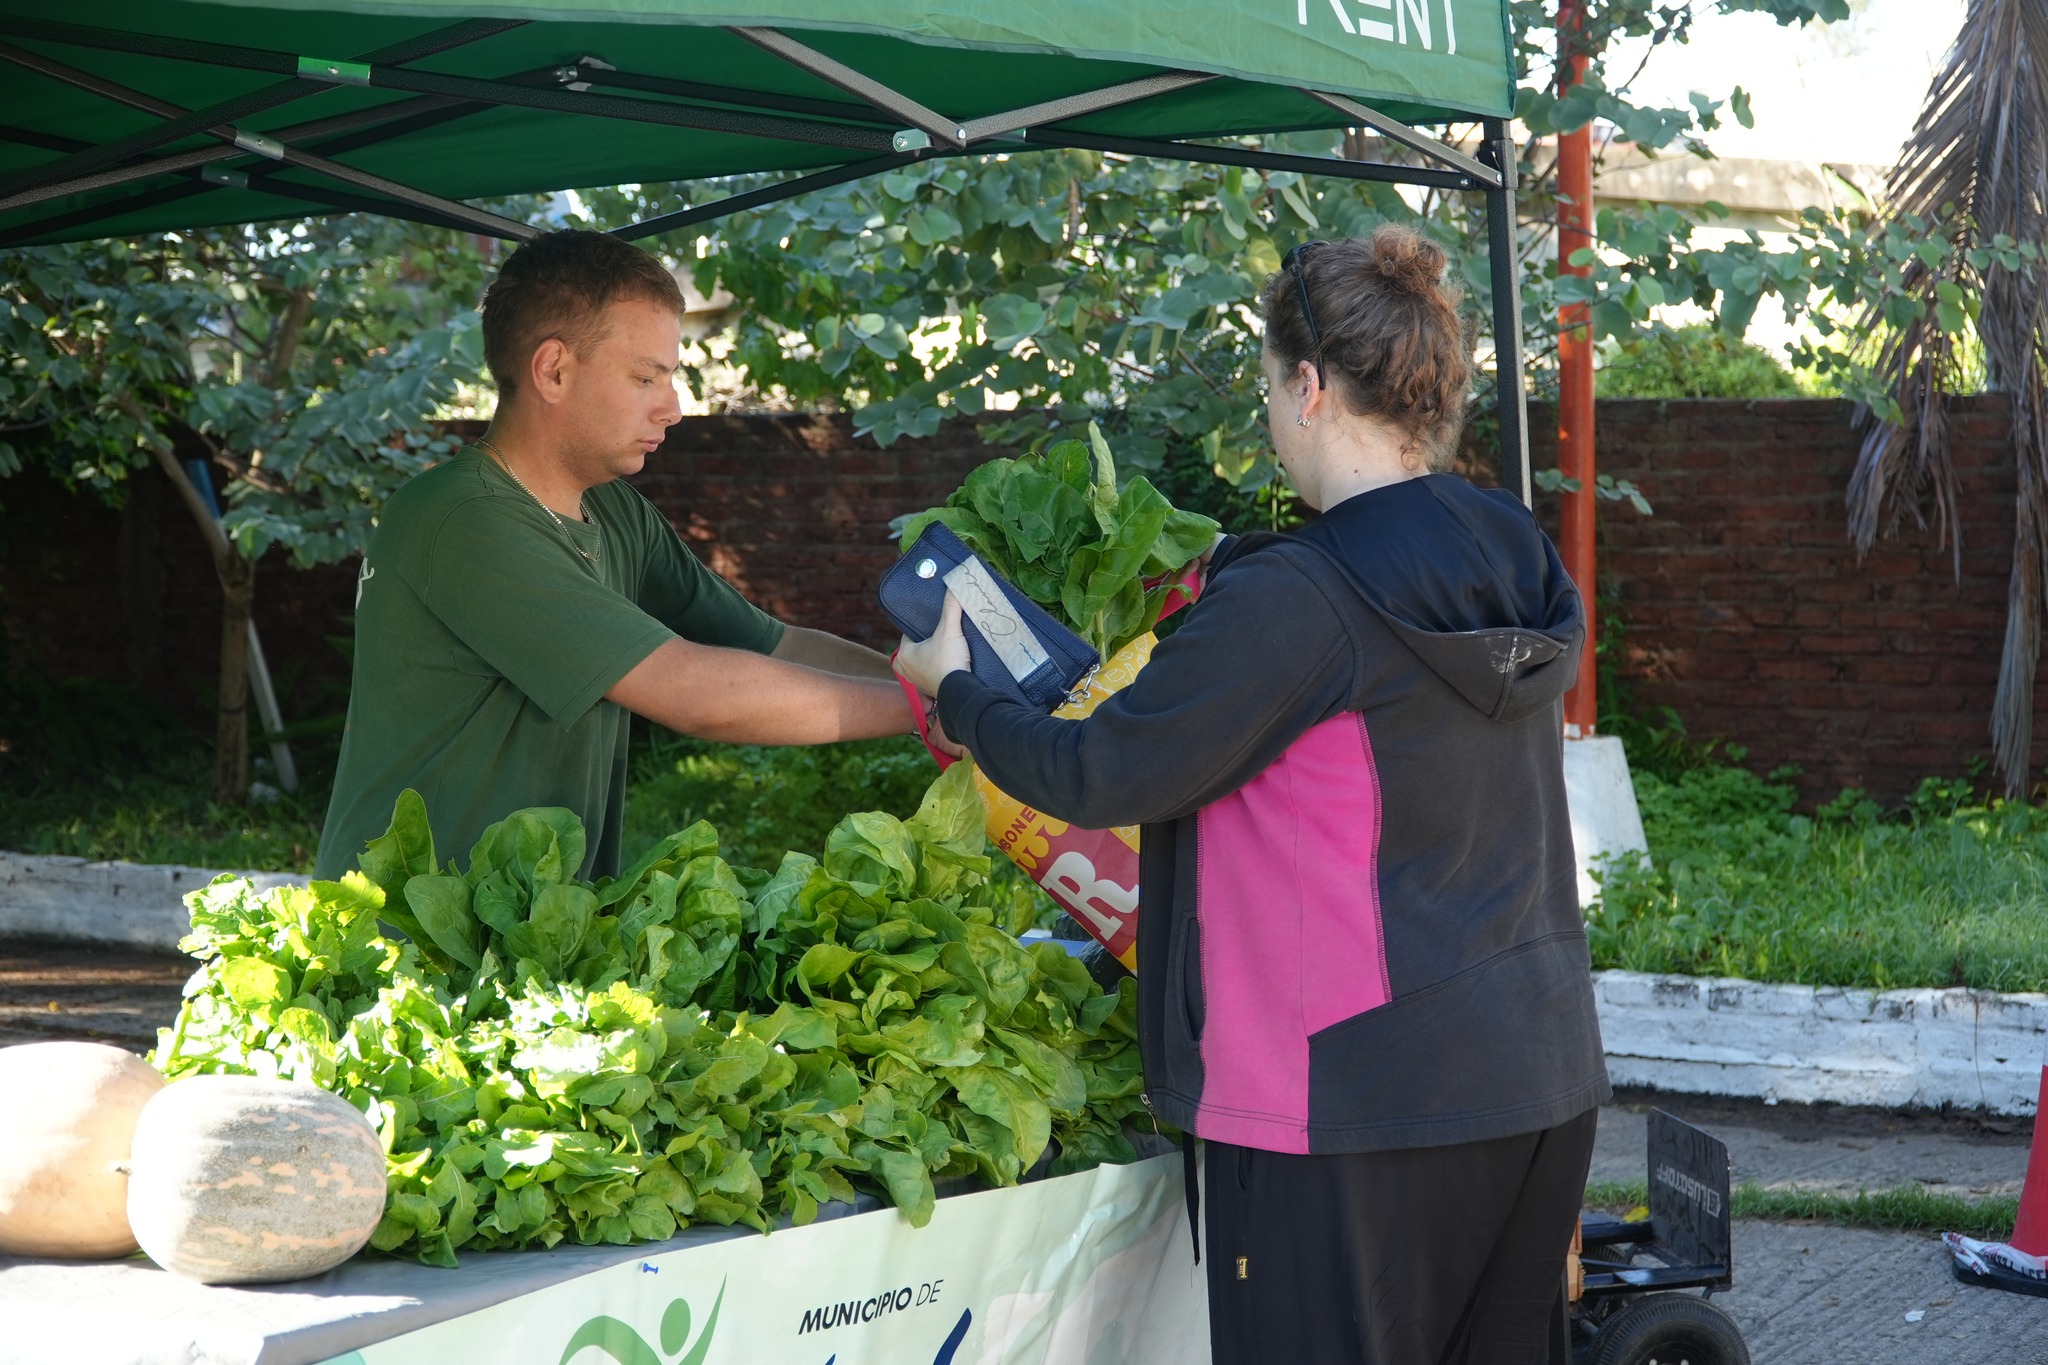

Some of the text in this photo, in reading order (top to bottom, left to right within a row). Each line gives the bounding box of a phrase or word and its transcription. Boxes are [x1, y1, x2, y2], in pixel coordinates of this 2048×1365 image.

[996, 806, 1037, 855] BONE
[798, 1279, 944, 1335] MUNICIPIO DE
